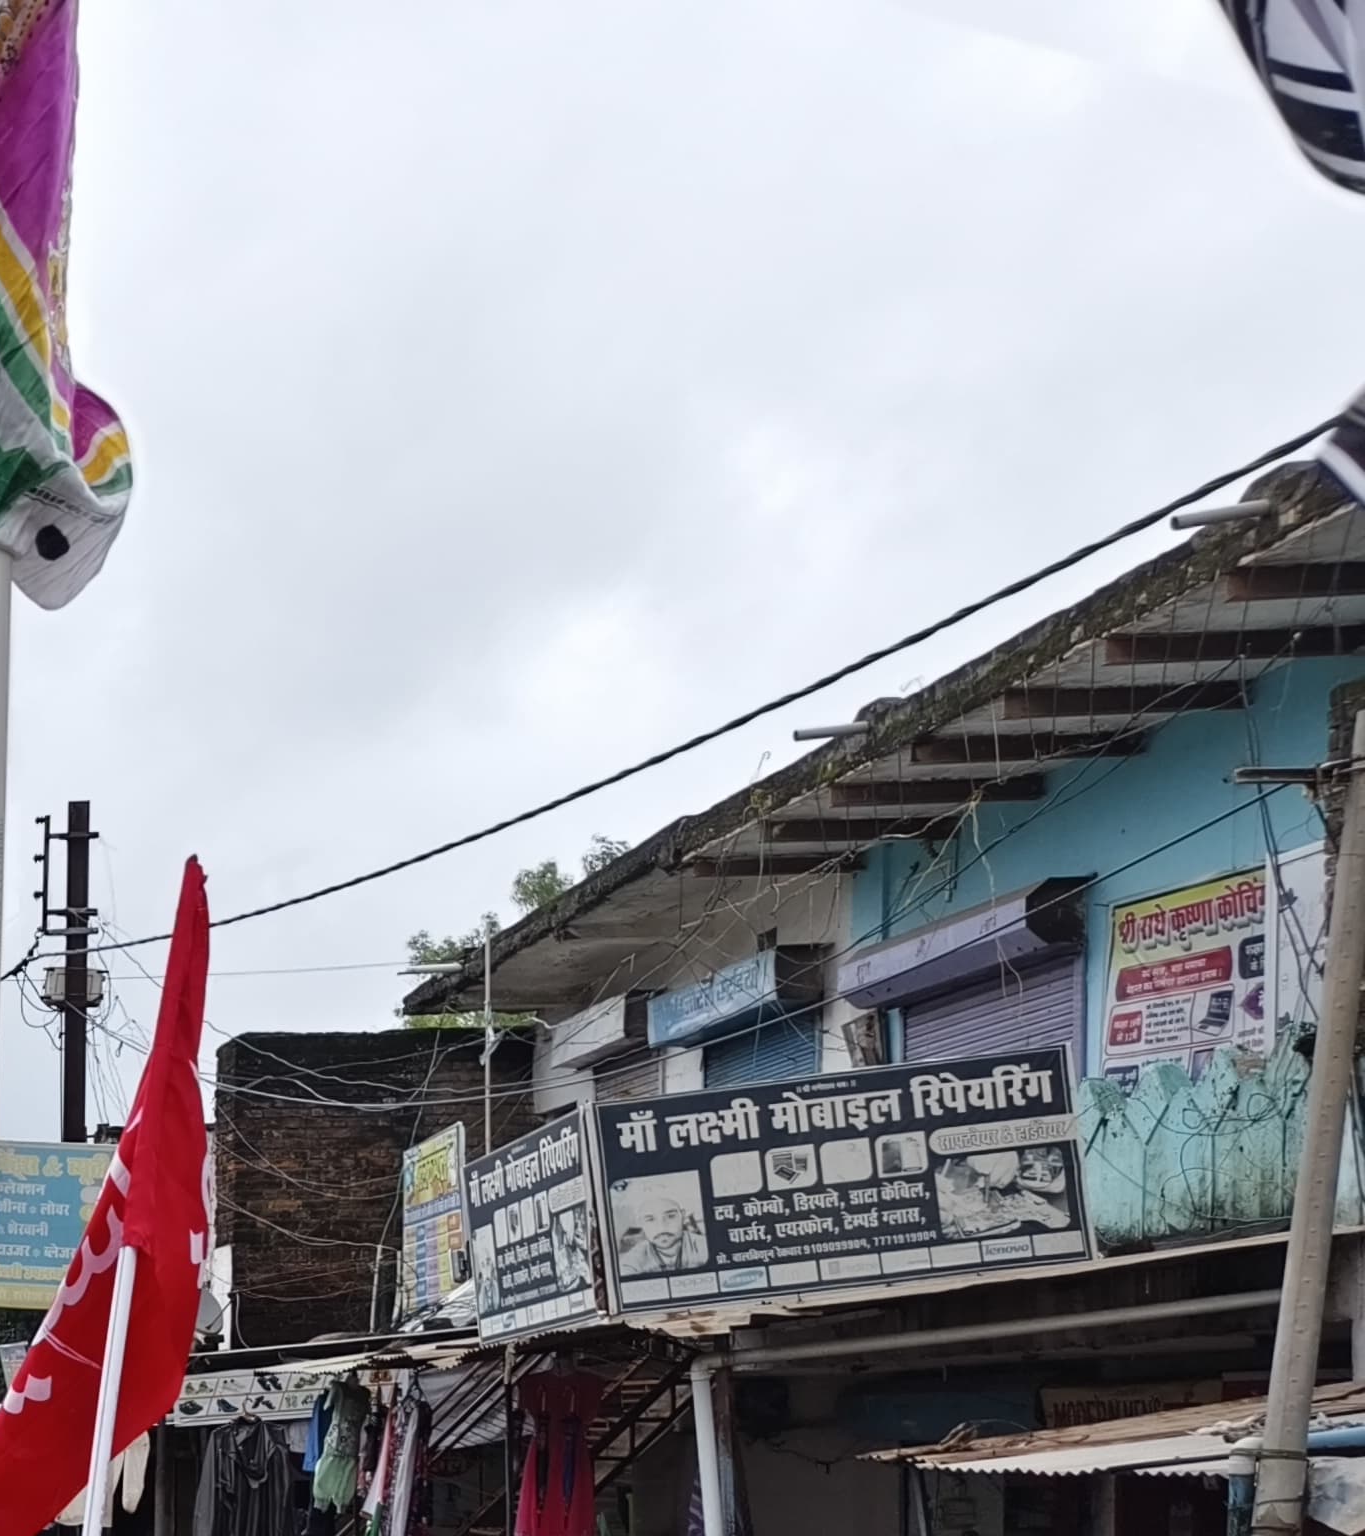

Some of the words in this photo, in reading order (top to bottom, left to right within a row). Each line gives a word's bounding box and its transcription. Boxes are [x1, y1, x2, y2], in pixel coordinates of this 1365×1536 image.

[1120, 912, 1136, 944] श्री
[1139, 904, 1167, 940] राधे
[1170, 897, 1215, 940] कृष्णा
[617, 1110, 656, 1153] माँ
[666, 1098, 760, 1148] लक्ष्मी
[769, 1091, 902, 1133] मोबाइल
[909, 1064, 1053, 1119] रिपेयरिंग
[481, 1160, 505, 1204] लक्ष्मी
[505, 1154, 541, 1190] मोबाइल
[713, 1204, 740, 1222] टच,
[848, 1188, 878, 1205] डाटा
[728, 1222, 772, 1243] चार्जर,
[775, 1214, 840, 1238] एयरफोन,
[983, 1241, 1030, 1256] lenovo
